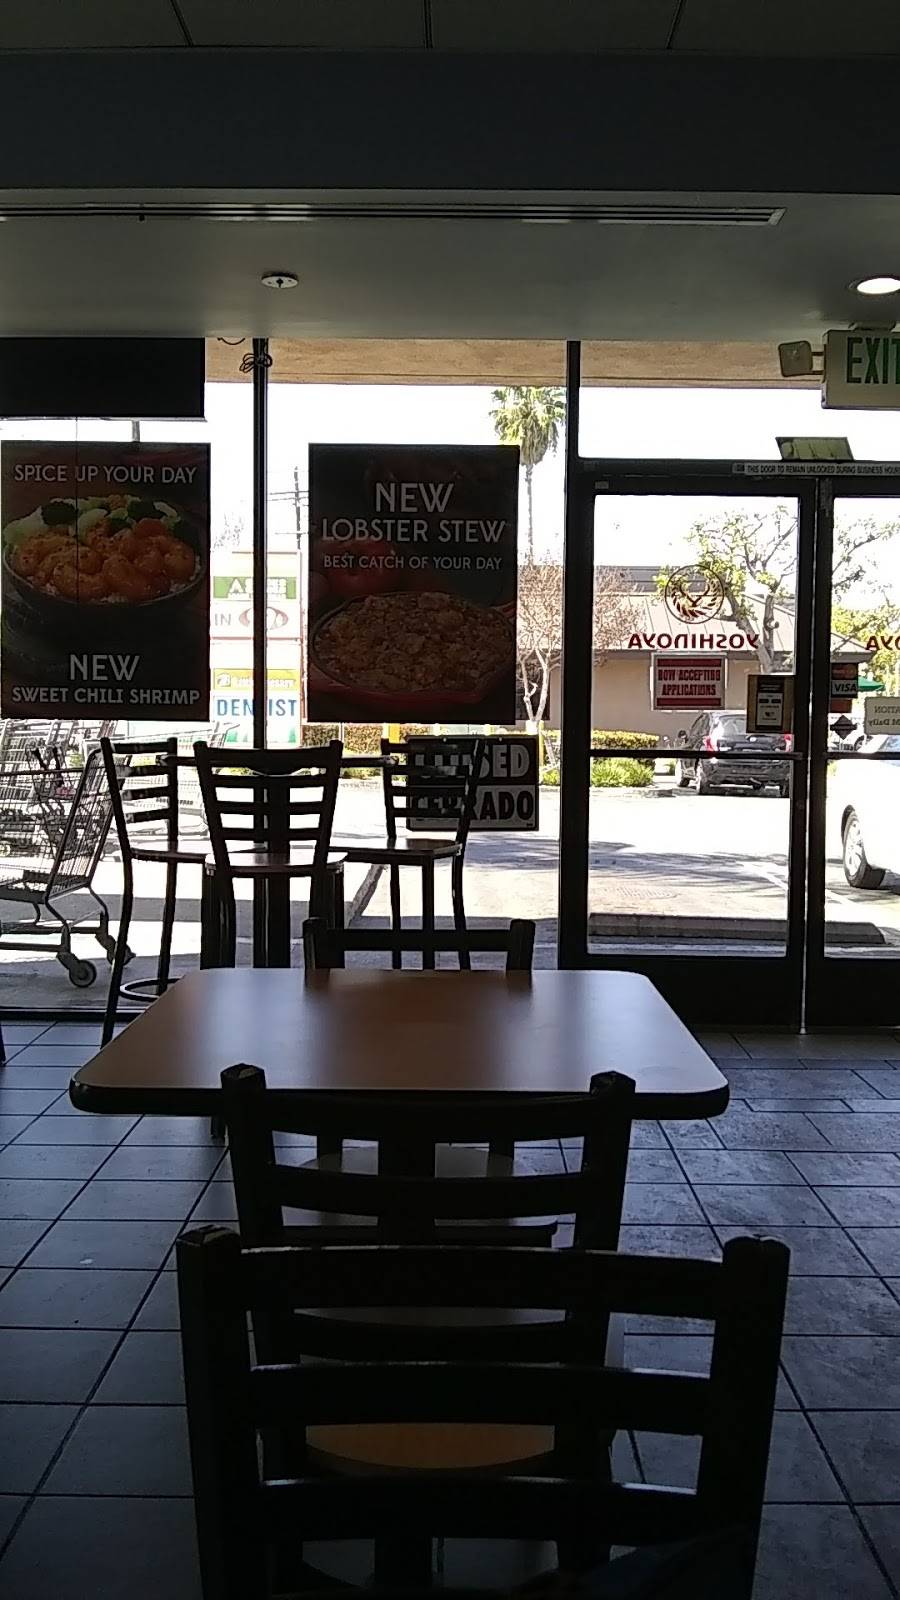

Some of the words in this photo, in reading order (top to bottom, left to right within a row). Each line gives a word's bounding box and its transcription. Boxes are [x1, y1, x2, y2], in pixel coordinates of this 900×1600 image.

[14, 464, 68, 482] SPICE
[75, 465, 99, 482] UP
[103, 466, 155, 483] YOUR
[161, 467, 197, 484] DAY
[747, 464, 758, 473] THIS
[761, 464, 776, 473] DOOR
[778, 464, 785, 473] TO
[786, 464, 805, 473] REMAIN
[807, 465, 835, 474] UNLOCKED
[836, 465, 856, 474] DURING
[857, 465, 884, 474] BUSINESS
[375, 482, 454, 513] NEW
[321, 518, 429, 542] LOBSTER
[438, 519, 506, 543] STEW
[323, 555, 355, 569] BEST
[358, 556, 405, 569] CATCH
[408, 556, 429, 569] OF
[432, 556, 472, 569] YOUR
[475, 557, 503, 570] DAY
[69, 653, 141, 681] NEW
[12, 686, 69, 703] SWEET
[73, 687, 124, 704] CHILI
[129, 688, 201, 705] SHRIMP
[661, 684, 716, 696] APPLICATIONS
[834, 682, 857, 692] VISA
[217, 698, 297, 717] DENIST
